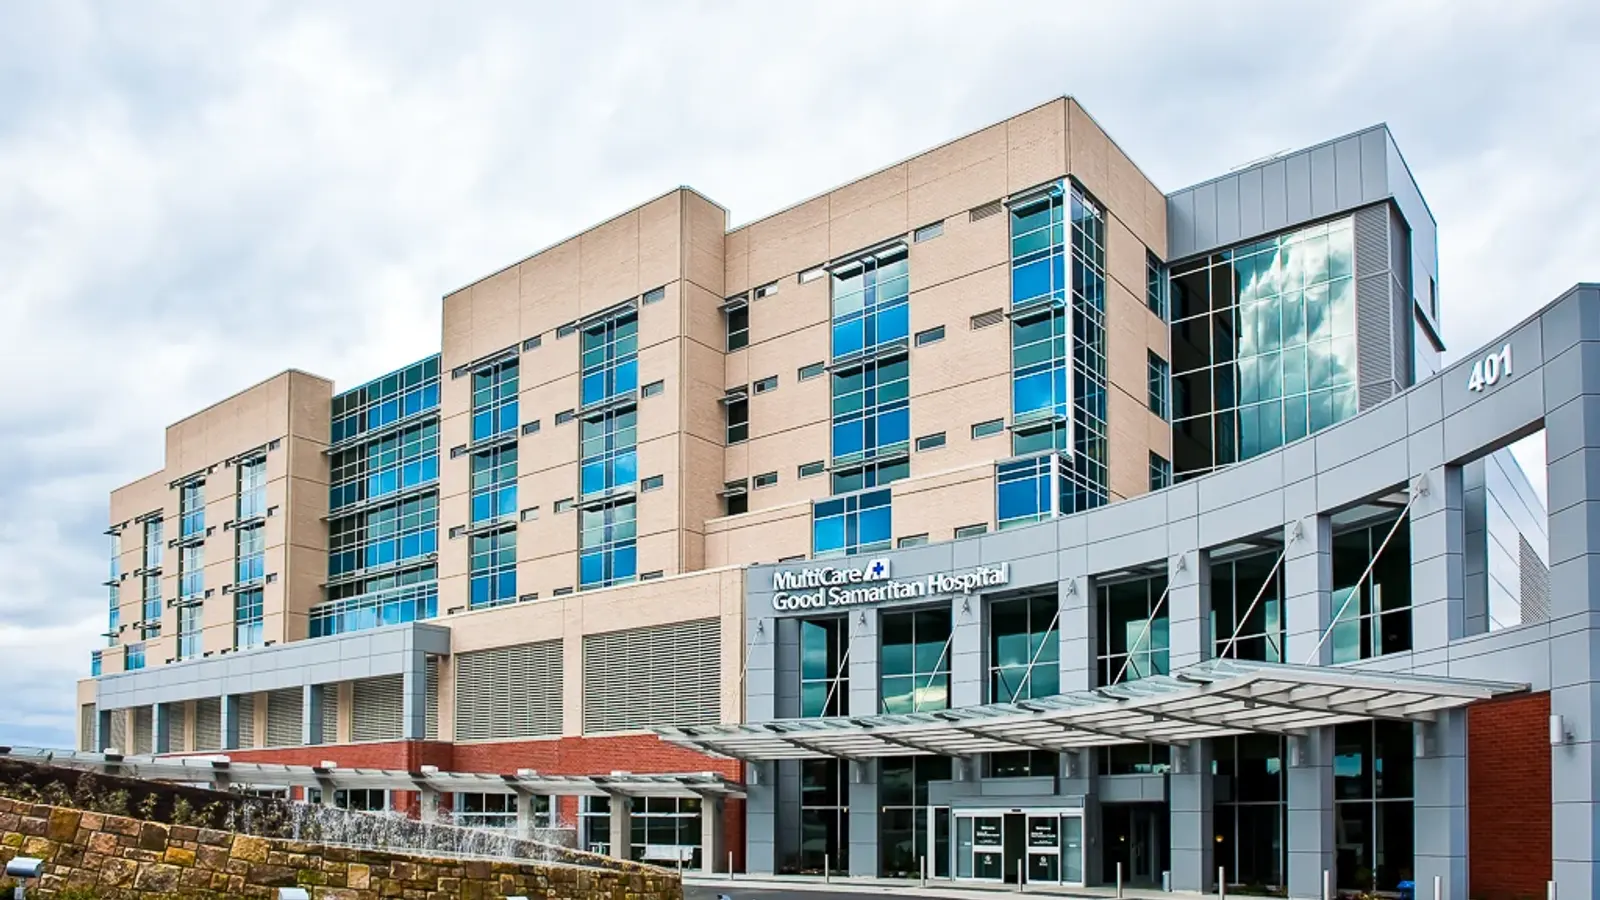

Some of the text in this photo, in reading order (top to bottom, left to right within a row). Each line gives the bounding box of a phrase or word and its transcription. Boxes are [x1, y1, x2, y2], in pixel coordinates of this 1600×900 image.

[1468, 343, 1513, 392] 401
[772, 566, 862, 590] MultiCare
[772, 562, 1010, 611] Good Samaritan Hospital
